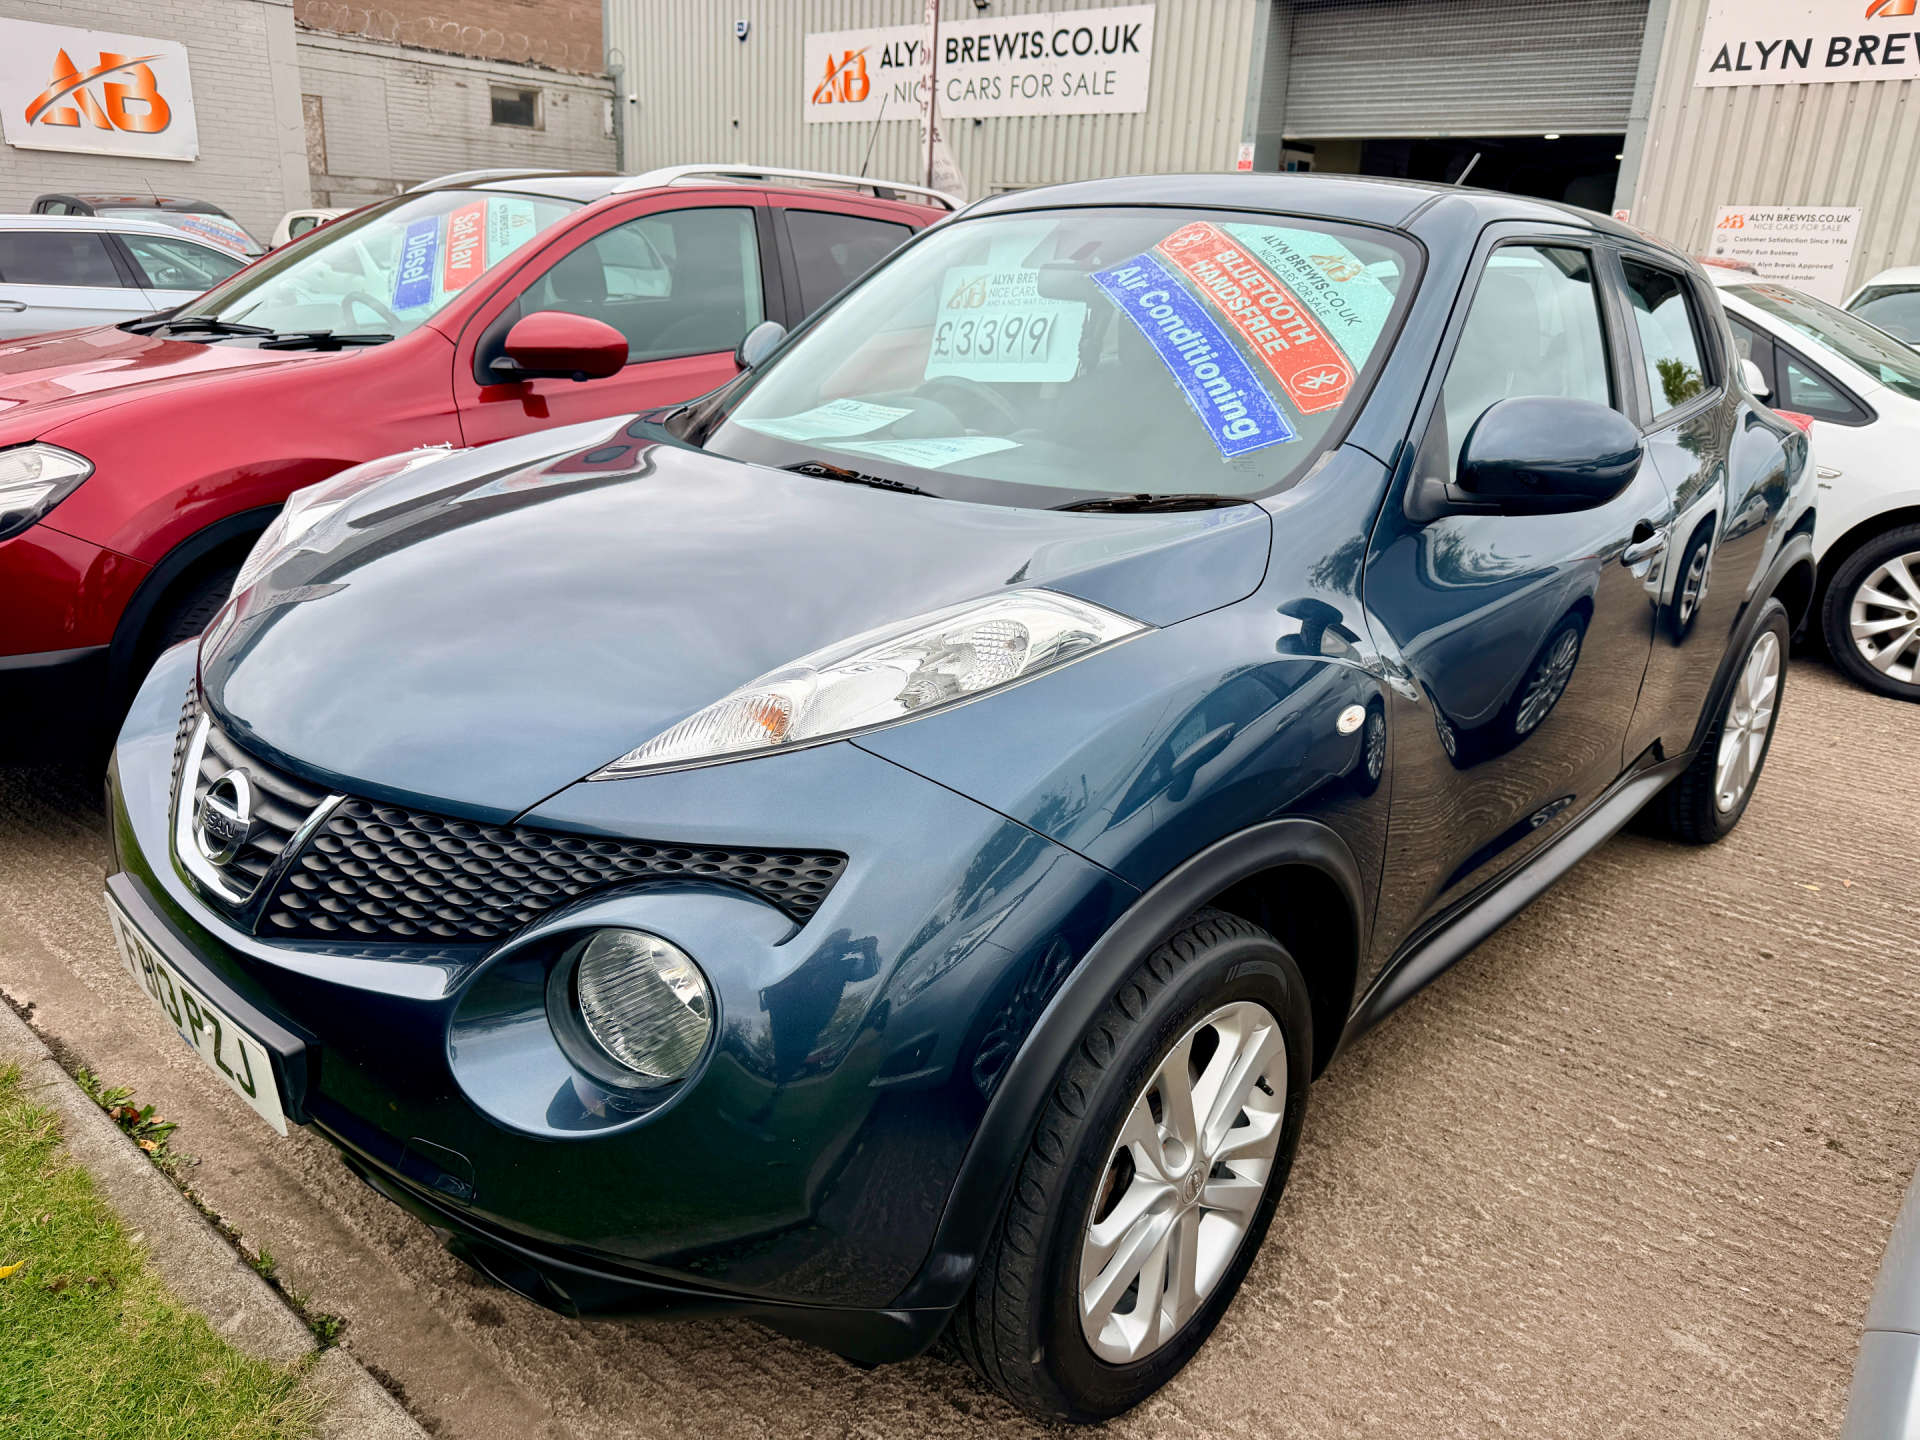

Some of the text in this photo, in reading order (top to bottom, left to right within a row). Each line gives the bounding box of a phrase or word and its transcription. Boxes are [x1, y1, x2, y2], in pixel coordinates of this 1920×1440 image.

[880, 23, 1142, 68] ALY BREWIS.CO.UK
[1709, 32, 1920, 73] ALYN BRE
[946, 76, 1001, 101] CARS
[1010, 73, 1053, 98] FOR
[1062, 70, 1117, 97] SALE
[1748, 213, 1852, 223] ALYN BREWIS.CO.UK
[1753, 222, 1842, 232] NICE CARS FOR SALE
[402, 231, 434, 285] Diesel
[451, 212, 480, 269] Sat-Nav
[1731, 248, 1754, 256] Family
[1734, 235, 1767, 243] Customer
[1768, 236, 1809, 244] Satisfaction
[1810, 237, 1829, 245] Since
[988, 287, 1036, 297] NICE CARS
[992, 271, 1039, 285] ALYN BRE
[1215, 249, 1318, 345] BLUETOOTH
[1260, 249, 1331, 317] NICE CARS FOR SALE
[1261, 234, 1363, 326] ALYN BREWIS.CO.UK
[1189, 259, 1290, 356] HANDSFREE
[934, 316, 1049, 356] £3399
[1111, 265, 1261, 440] Air Conditioning
[180, 985, 257, 1099] PZJ
